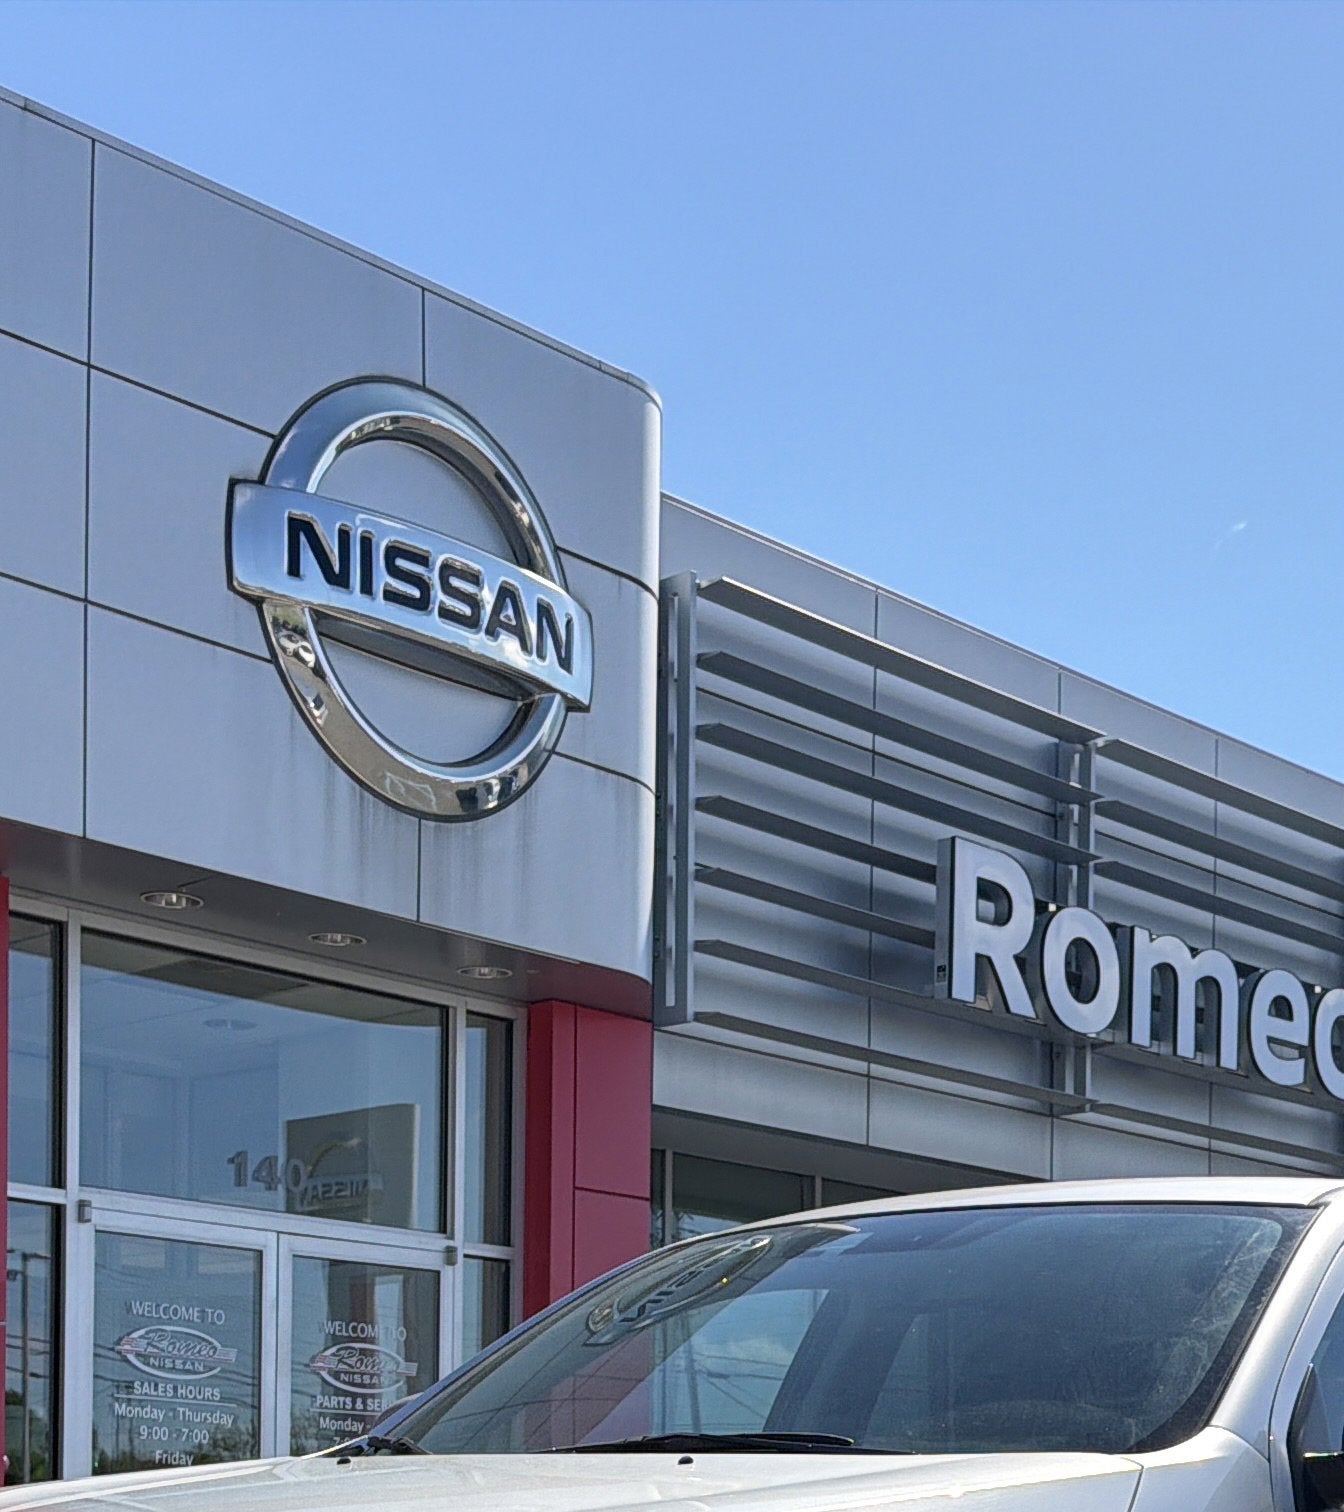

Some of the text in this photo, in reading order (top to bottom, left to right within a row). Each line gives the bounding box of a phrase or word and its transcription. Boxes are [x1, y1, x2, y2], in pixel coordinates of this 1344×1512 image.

[286, 510, 574, 675] NISSAN
[227, 1150, 307, 1193] 140
[130, 1300, 226, 1325] WELCOME TO
[323, 1320, 387, 1339] WELCOM
[138, 1328, 218, 1358] Romeo
[149, 1357, 205, 1372] NISSAN
[133, 1380, 221, 1401] SALES HOURS
[316, 1394, 353, 1410] PARTS
[355, 1396, 364, 1410] &
[114, 1402, 166, 1423] Monday
[177, 1407, 235, 1428] Thursday
[140, 1425, 169, 1441] 9:00
[181, 1428, 210, 1444] 7:00
[319, 1416, 365, 1435] Monday
[156, 1450, 195, 1467] Friday
